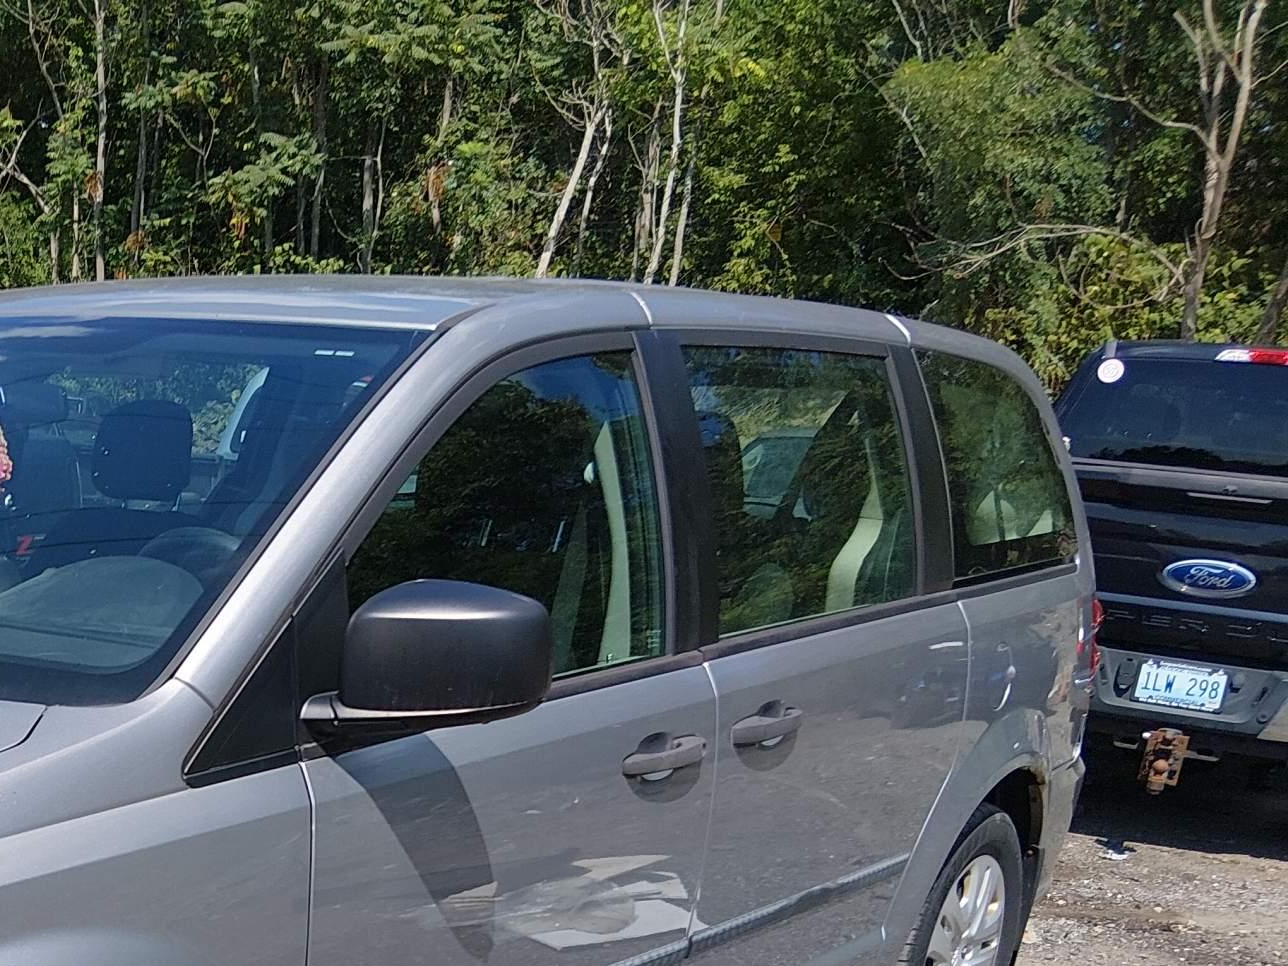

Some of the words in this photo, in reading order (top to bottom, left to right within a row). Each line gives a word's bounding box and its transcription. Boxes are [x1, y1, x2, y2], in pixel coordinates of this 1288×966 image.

[1184, 566, 1235, 588] Ford
[1140, 671, 1177, 694] 1LW
[1186, 677, 1220, 700] 298
